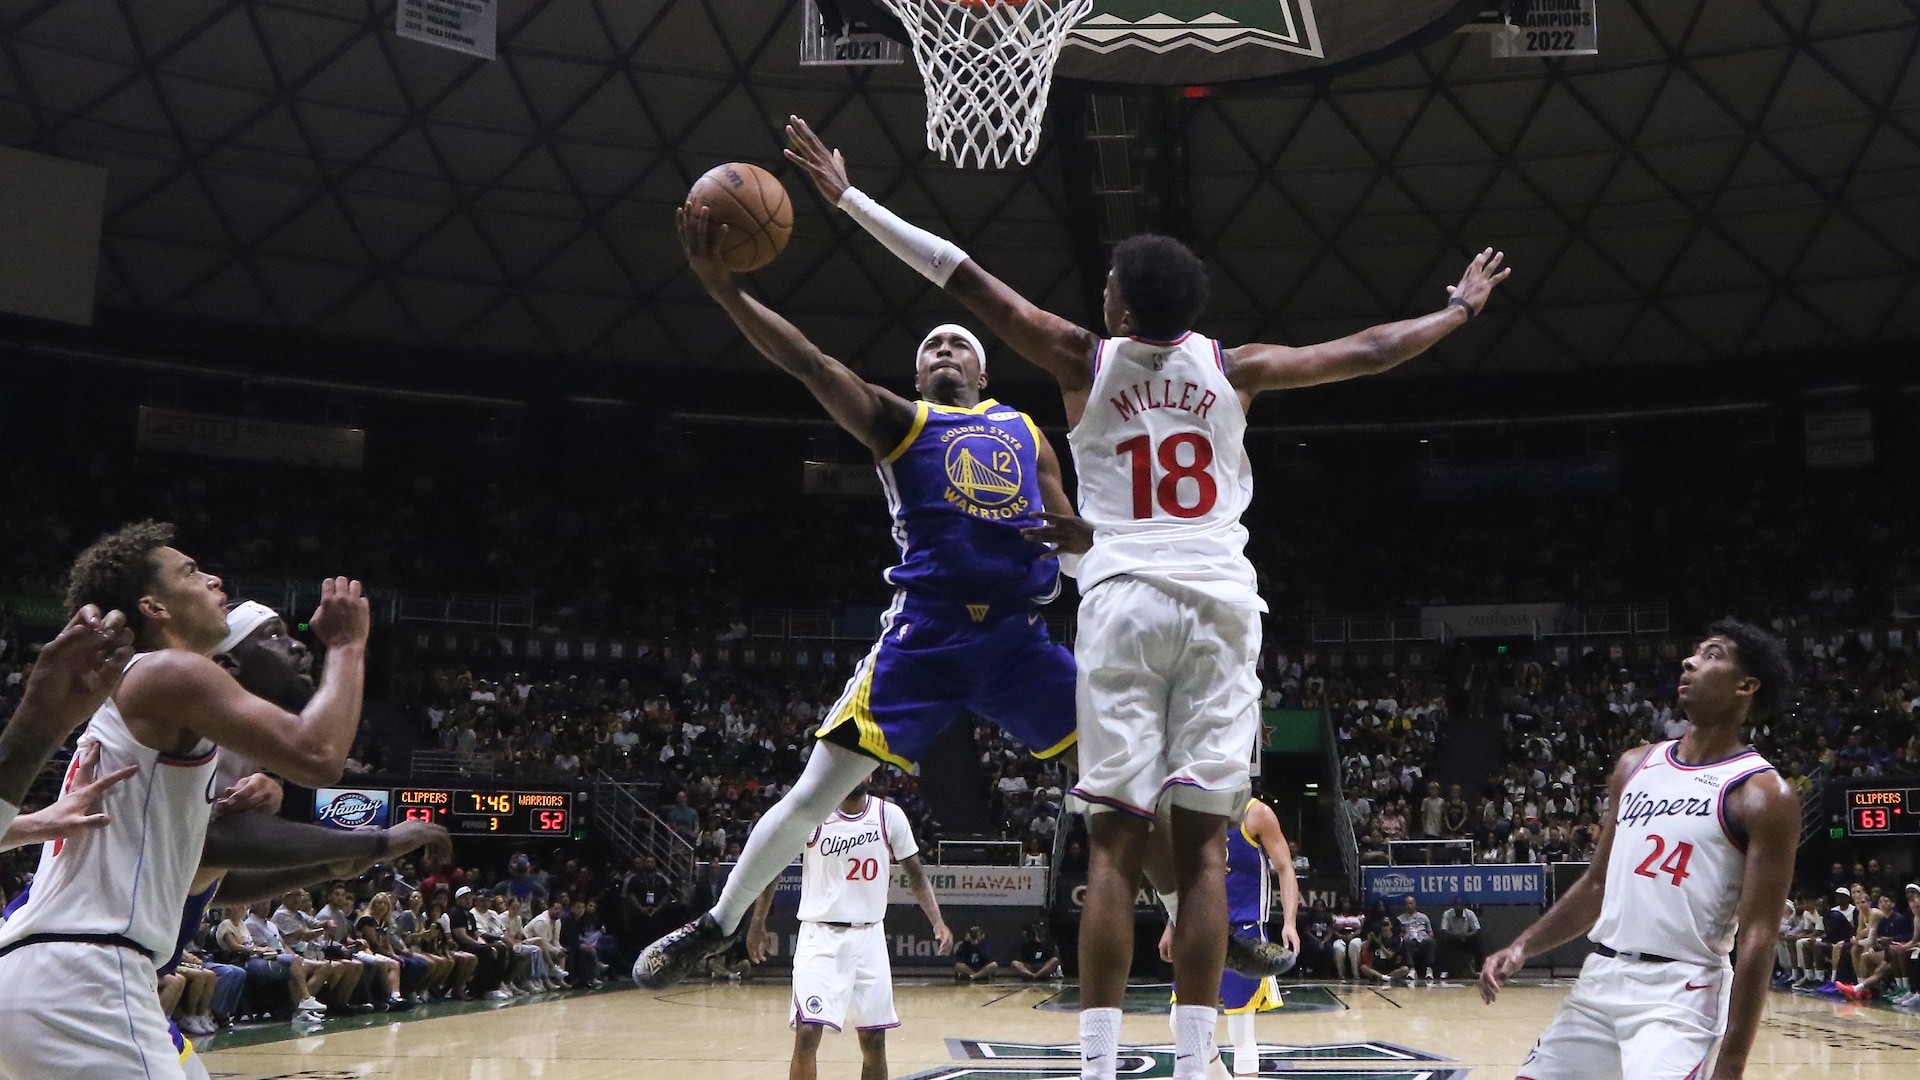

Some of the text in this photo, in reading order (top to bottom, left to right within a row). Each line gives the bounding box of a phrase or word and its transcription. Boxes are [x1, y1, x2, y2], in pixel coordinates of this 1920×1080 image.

[1526, 12, 1591, 28] AMPIONS
[1526, 30, 1575, 51] 2022
[836, 41, 880, 60] 2021
[1110, 379, 1217, 422] MILLER
[941, 425, 1022, 450] GOLDEN STATE
[992, 451, 1012, 473] 12
[1116, 432, 1217, 519] 18
[943, 486, 1029, 520] WARRIORS
[1467, 614, 1527, 627] CALIFORNIA
[402, 791, 448, 804] CLIPPERS
[471, 794, 510, 813] 7:46
[518, 795, 564, 806] WARRIORS
[1856, 793, 1902, 805] CLIPPERS
[1617, 791, 1711, 827] Clippers
[489, 817, 498, 831] 3
[540, 811, 563, 830] 52
[1861, 810, 1886, 828] 63
[820, 830, 880, 857] Clippers
[846, 858, 879, 881] 20
[1634, 834, 1694, 887] 24
[1420, 874, 1538, 892] LET'S GO 'BOWS!
